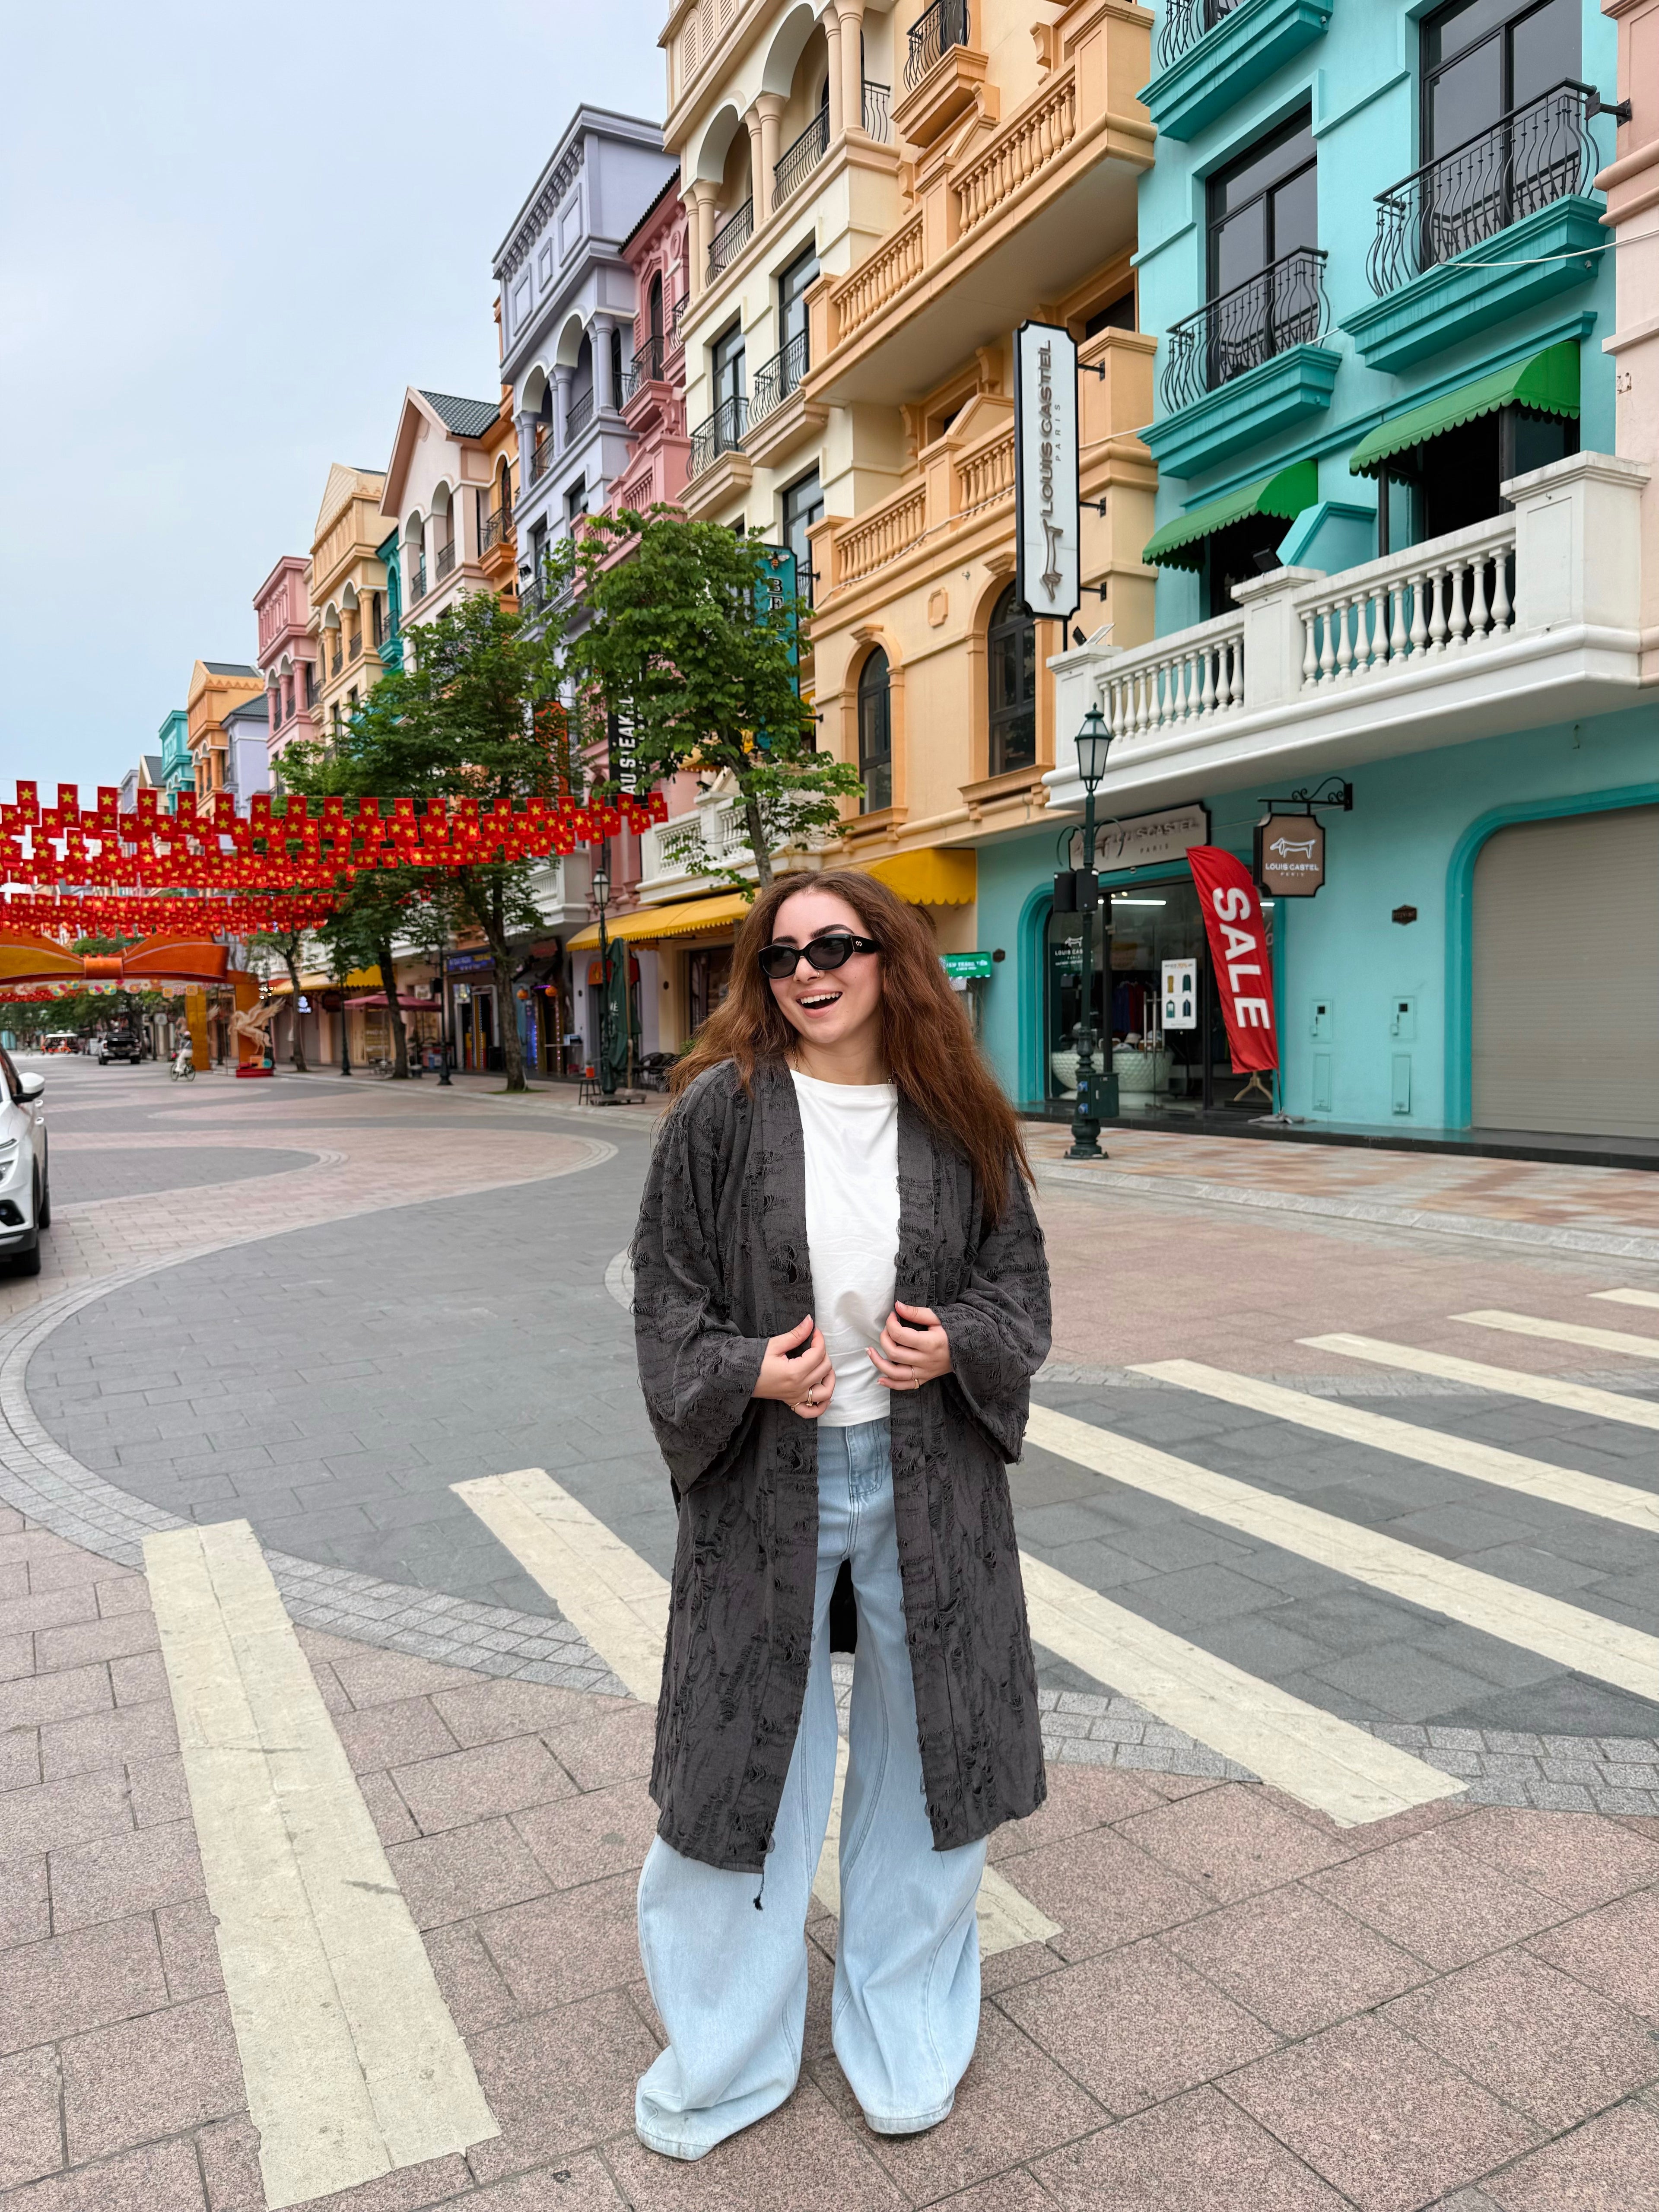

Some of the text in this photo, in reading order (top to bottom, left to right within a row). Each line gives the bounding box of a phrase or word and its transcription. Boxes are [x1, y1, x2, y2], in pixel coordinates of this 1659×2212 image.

[1038, 340, 1053, 517] LOUIS CASTEL
[1212, 887, 1271, 1029] SALE
